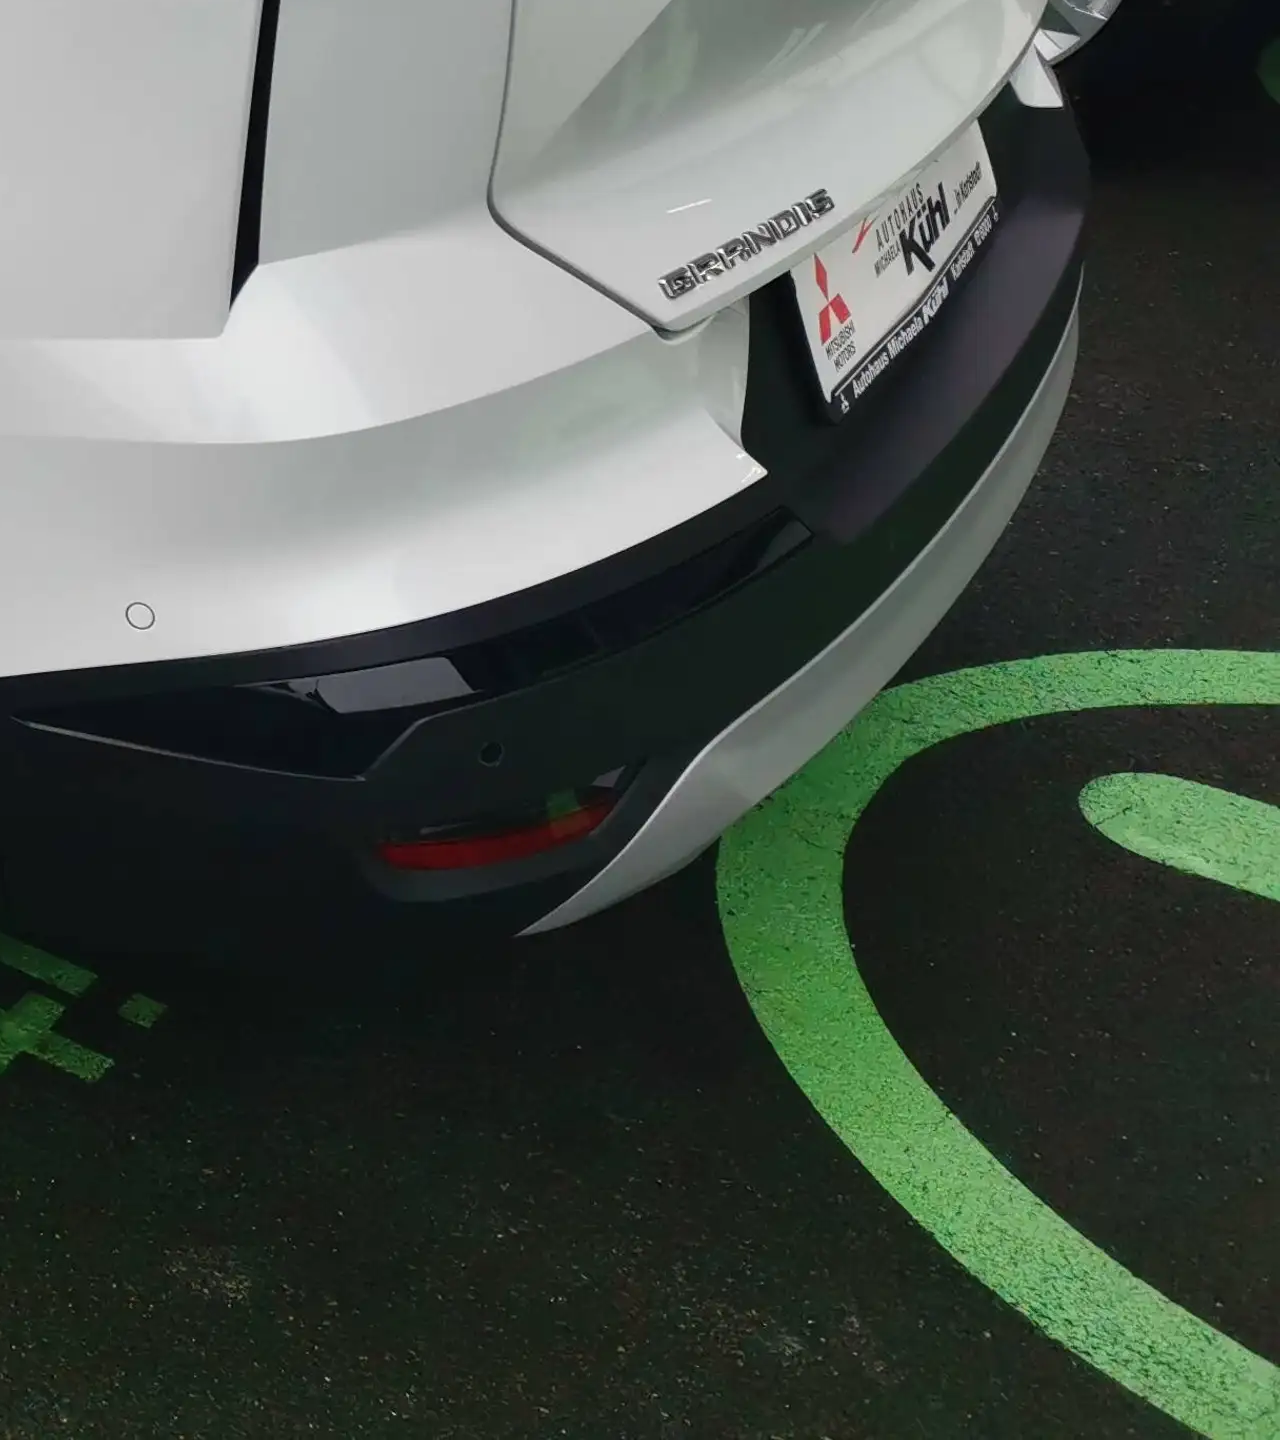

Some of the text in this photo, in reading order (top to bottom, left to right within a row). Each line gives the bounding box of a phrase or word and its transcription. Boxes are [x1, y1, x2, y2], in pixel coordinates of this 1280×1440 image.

[657, 188, 835, 300] GRANDIS
[874, 239, 901, 278] MICHAELA
[899, 180, 951, 276] Kühl
[876, 181, 924, 253] AUTOHAUS
[825, 319, 856, 361] MITSUBISHI
[834, 340, 856, 373] MOTORS
[852, 351, 890, 399] Autohaus
[887, 315, 924, 360] Michaela
